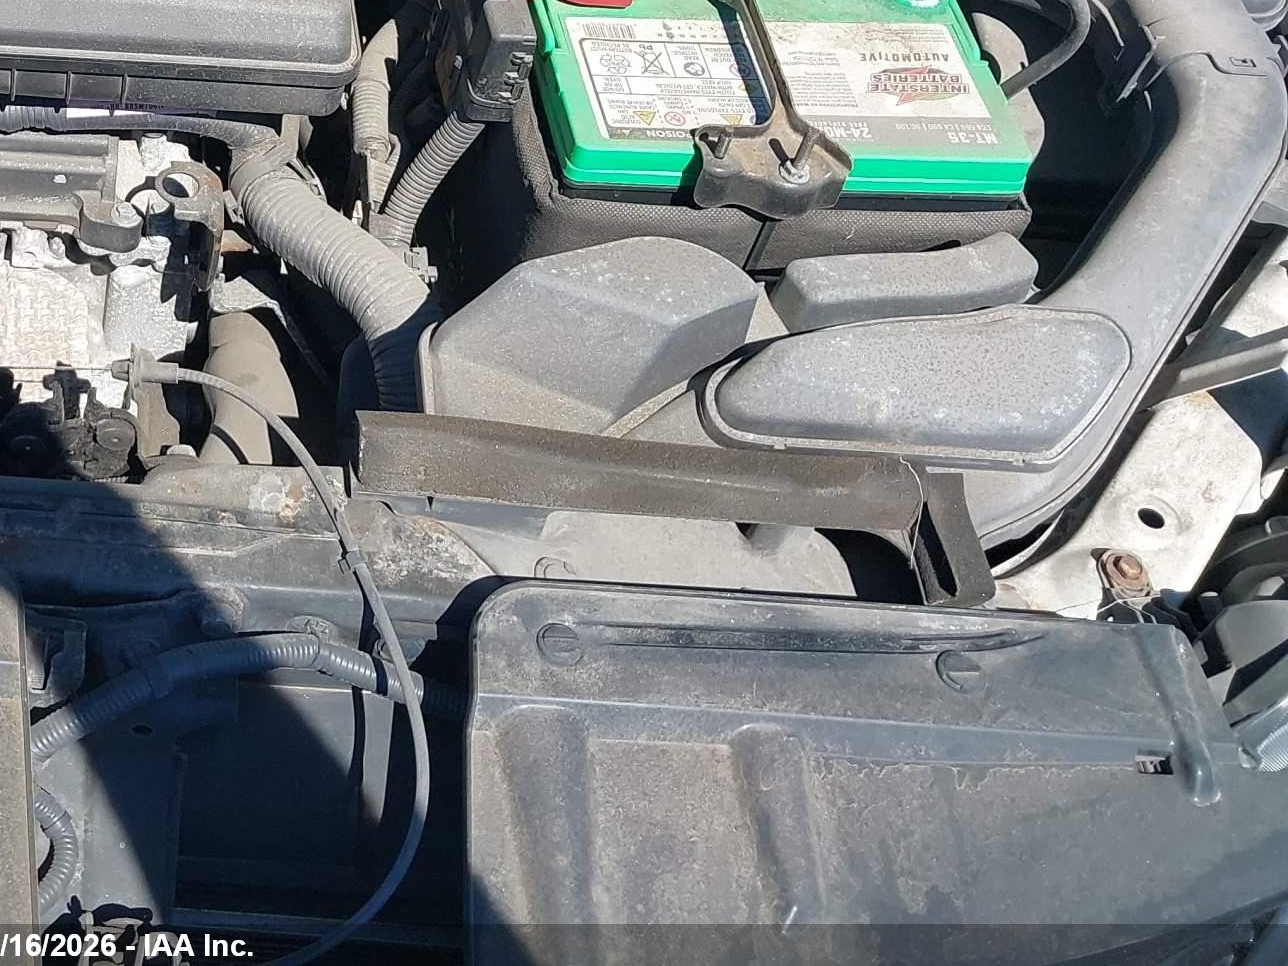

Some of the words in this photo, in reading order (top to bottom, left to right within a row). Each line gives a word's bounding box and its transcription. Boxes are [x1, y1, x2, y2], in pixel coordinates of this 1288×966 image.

[859, 52, 949, 62] AUTOMOTIVE
[872, 74, 960, 83] BATTERIES
[870, 83, 967, 93] INTERSTATE
[947, 131, 999, 144] MT-35
